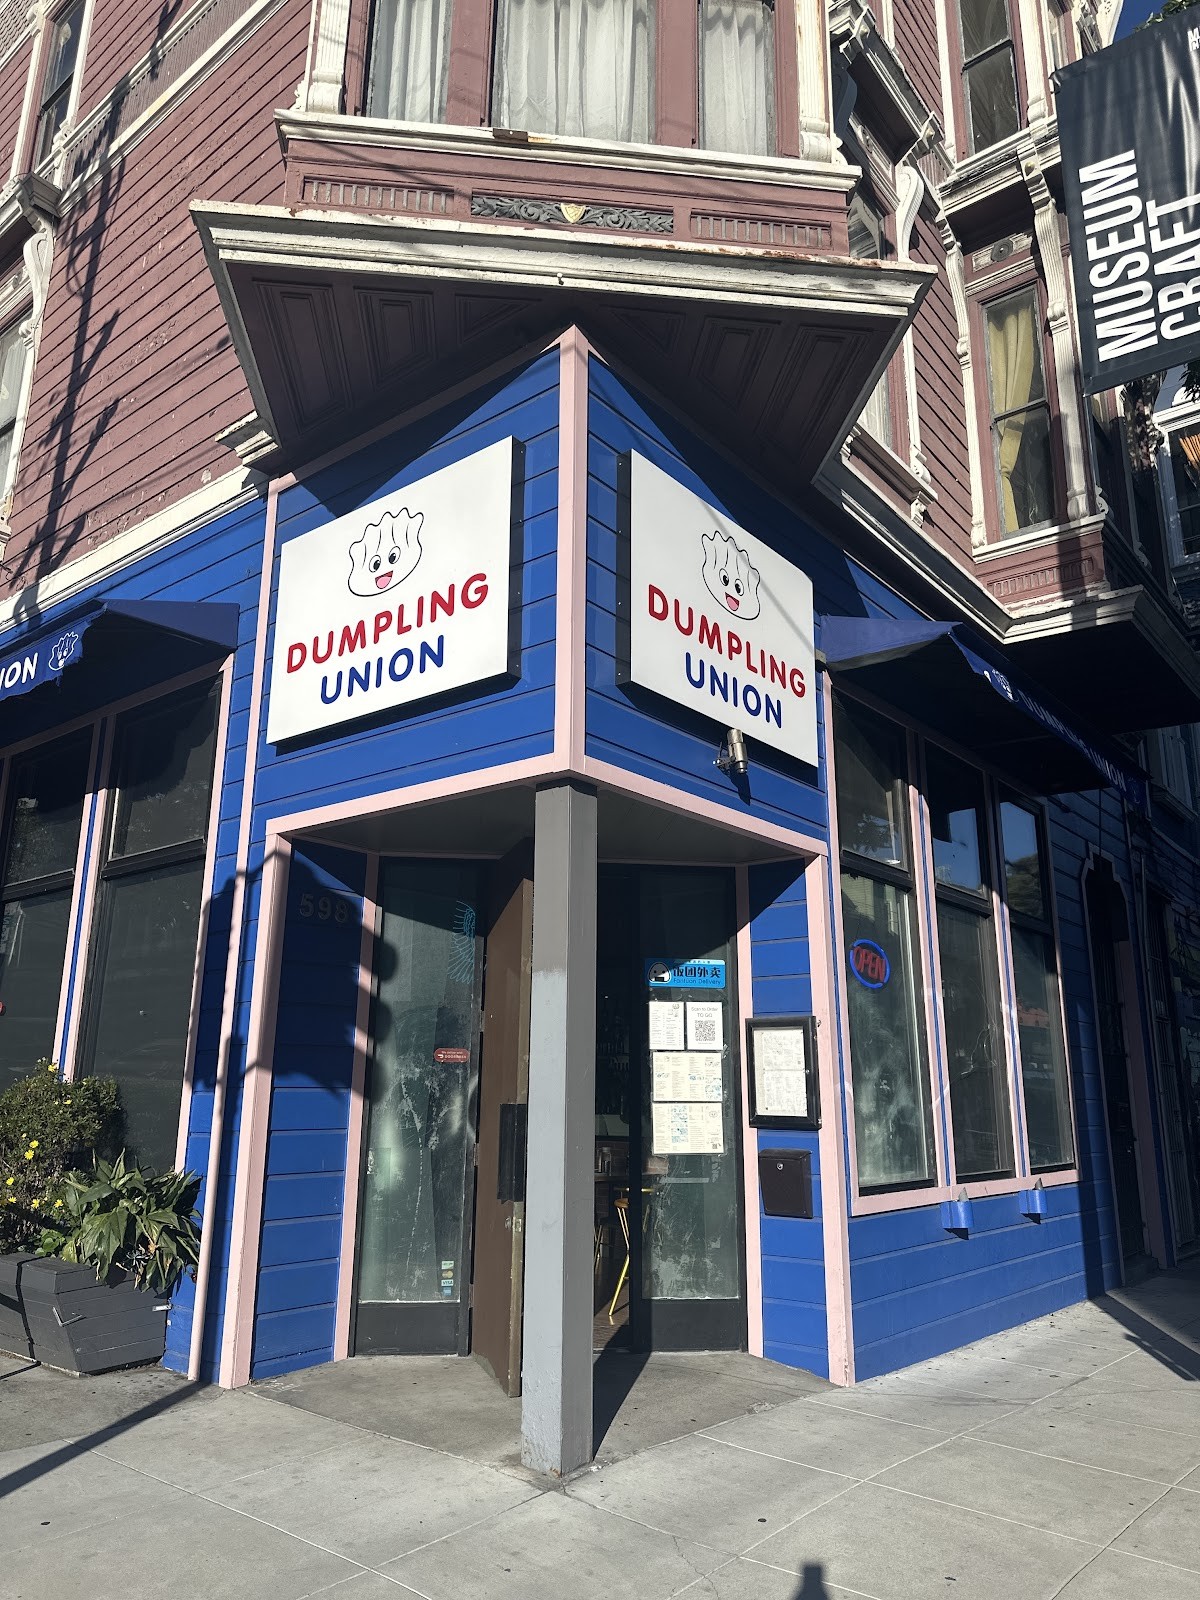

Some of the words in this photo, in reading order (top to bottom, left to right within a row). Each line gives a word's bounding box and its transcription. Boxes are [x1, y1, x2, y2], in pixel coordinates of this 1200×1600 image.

[1079, 149, 1158, 362] MUSEUM
[1146, 193, 1200, 340] CRAFT
[287, 573, 488, 673] DUMPLING
[649, 584, 806, 698] DUMPLING
[321, 635, 444, 704] UNION
[685, 652, 782, 728] UNION
[299, 892, 350, 923] 598
[854, 946, 886, 982] OPEN
